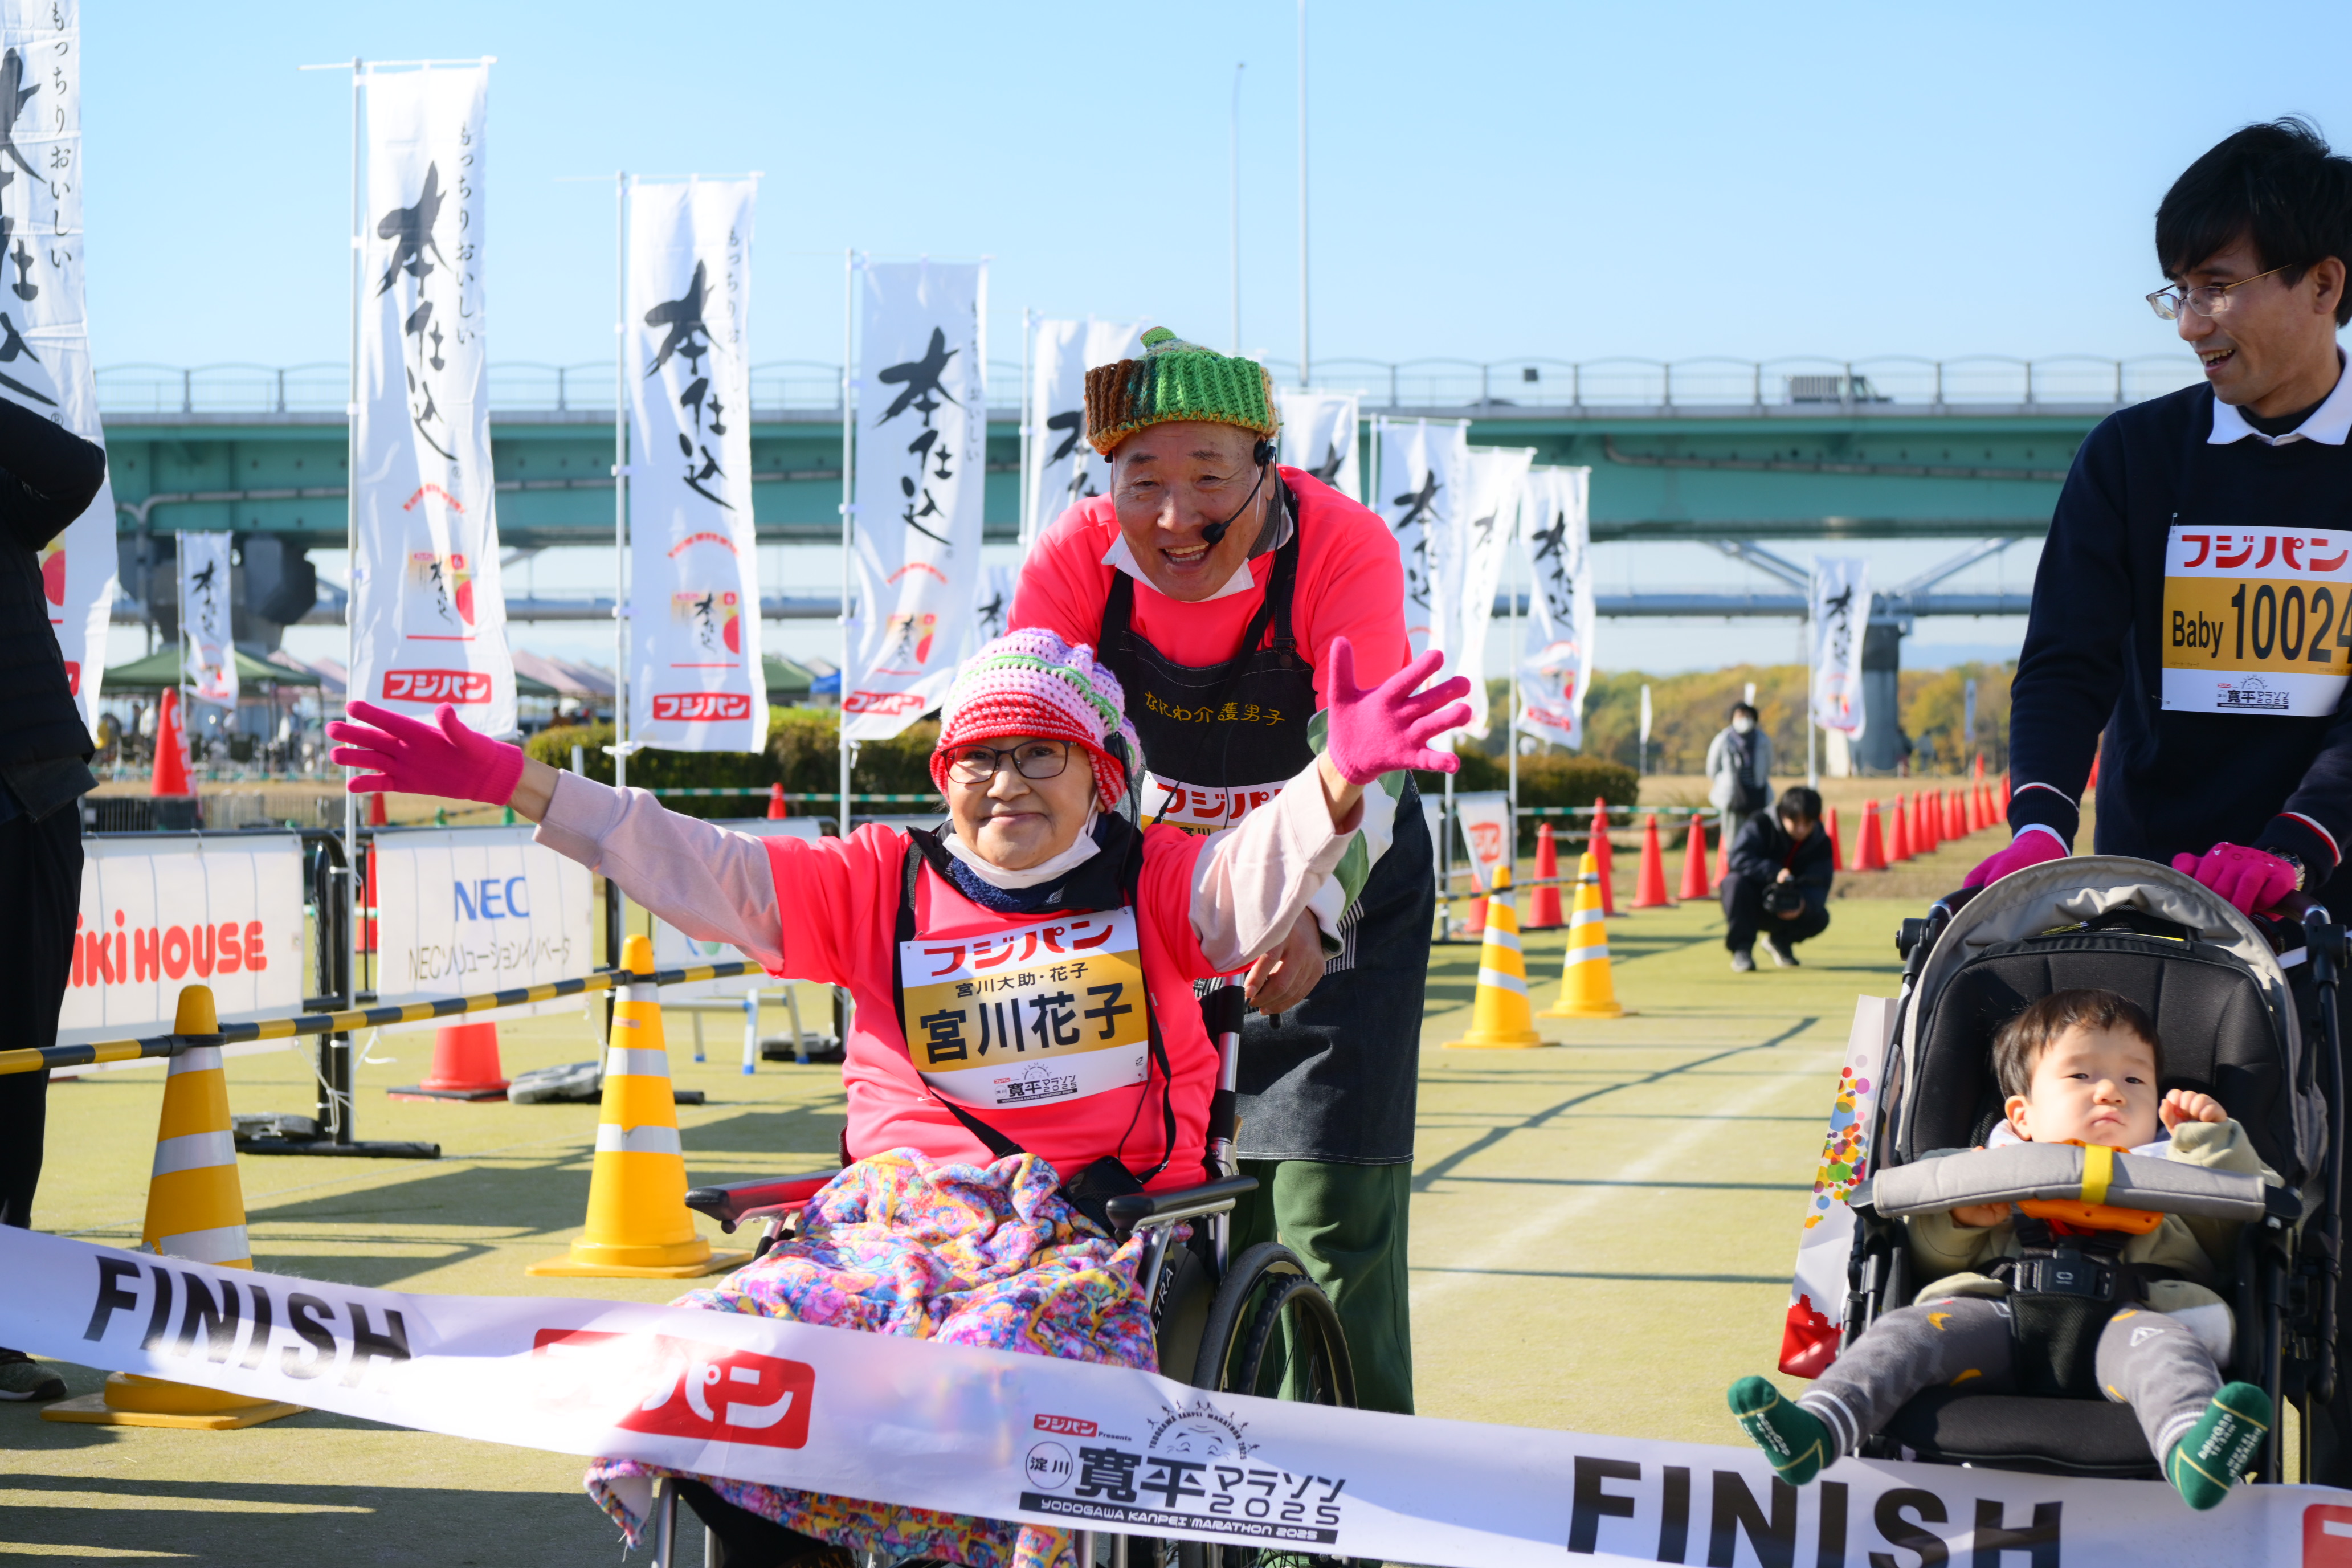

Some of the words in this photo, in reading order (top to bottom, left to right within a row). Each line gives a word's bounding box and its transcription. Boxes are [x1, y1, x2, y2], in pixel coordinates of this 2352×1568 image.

[51, 1, 72, 268] もっちりおいしい
[455, 121, 475, 345] もっちりおいしい
[2181, 534, 2349, 572] フジパン
[2173, 610, 2224, 658] Baby
[2231, 583, 2352, 664] 10024
[389, 673, 487, 700] フジパン
[656, 696, 748, 718] フジパン
[1144, 690, 1286, 726] なにわ介護男子
[1157, 782, 1282, 819] フジパ
[454, 876, 530, 922] NEC
[66, 909, 127, 988] iKi
[134, 920, 268, 983] HOUSE
[923, 920, 1113, 977] フジパン
[955, 962, 1089, 998] 宮川大助・花子
[920, 982, 1133, 1064] 宮川花子
[1154, 1267, 1174, 1336] LTRA
[83, 1255, 413, 1396] FINISH
[1038, 1416, 1095, 1435] フジパン
[1099, 1431, 1132, 1442] Presents
[1030, 1456, 1070, 1475] 淀川
[1040, 1498, 1125, 1521] YODOGAWA
[1128, 1510, 1187, 1528] KANPEI
[1191, 1516, 1273, 1537] MARATHON
[1276, 1526, 1318, 1540] 2025
[1208, 1493, 1341, 1526] 2025
[1567, 1455, 2063, 1568] FINISH
